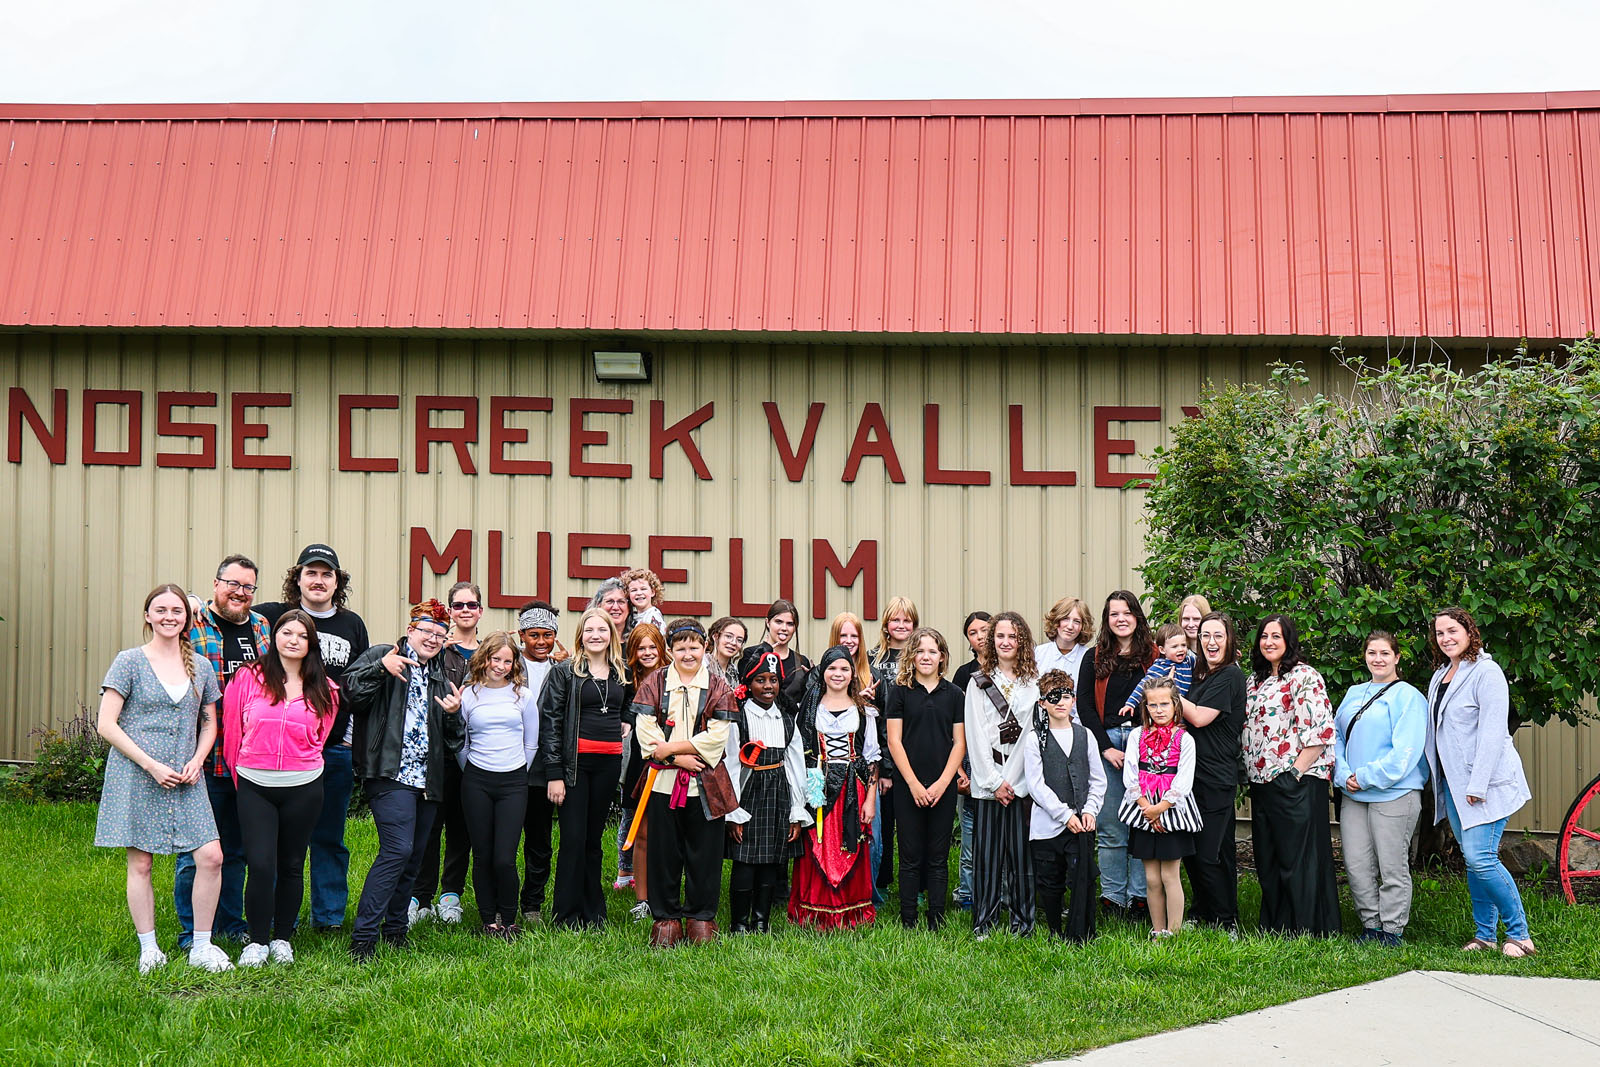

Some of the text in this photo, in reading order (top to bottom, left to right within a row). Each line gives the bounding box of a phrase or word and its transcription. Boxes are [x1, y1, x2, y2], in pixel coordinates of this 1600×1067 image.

[8, 387, 1205, 489] NOSE CREEK VALLE
[408, 526, 879, 621] MUSEUM
[237, 637, 256, 661] LIFE
